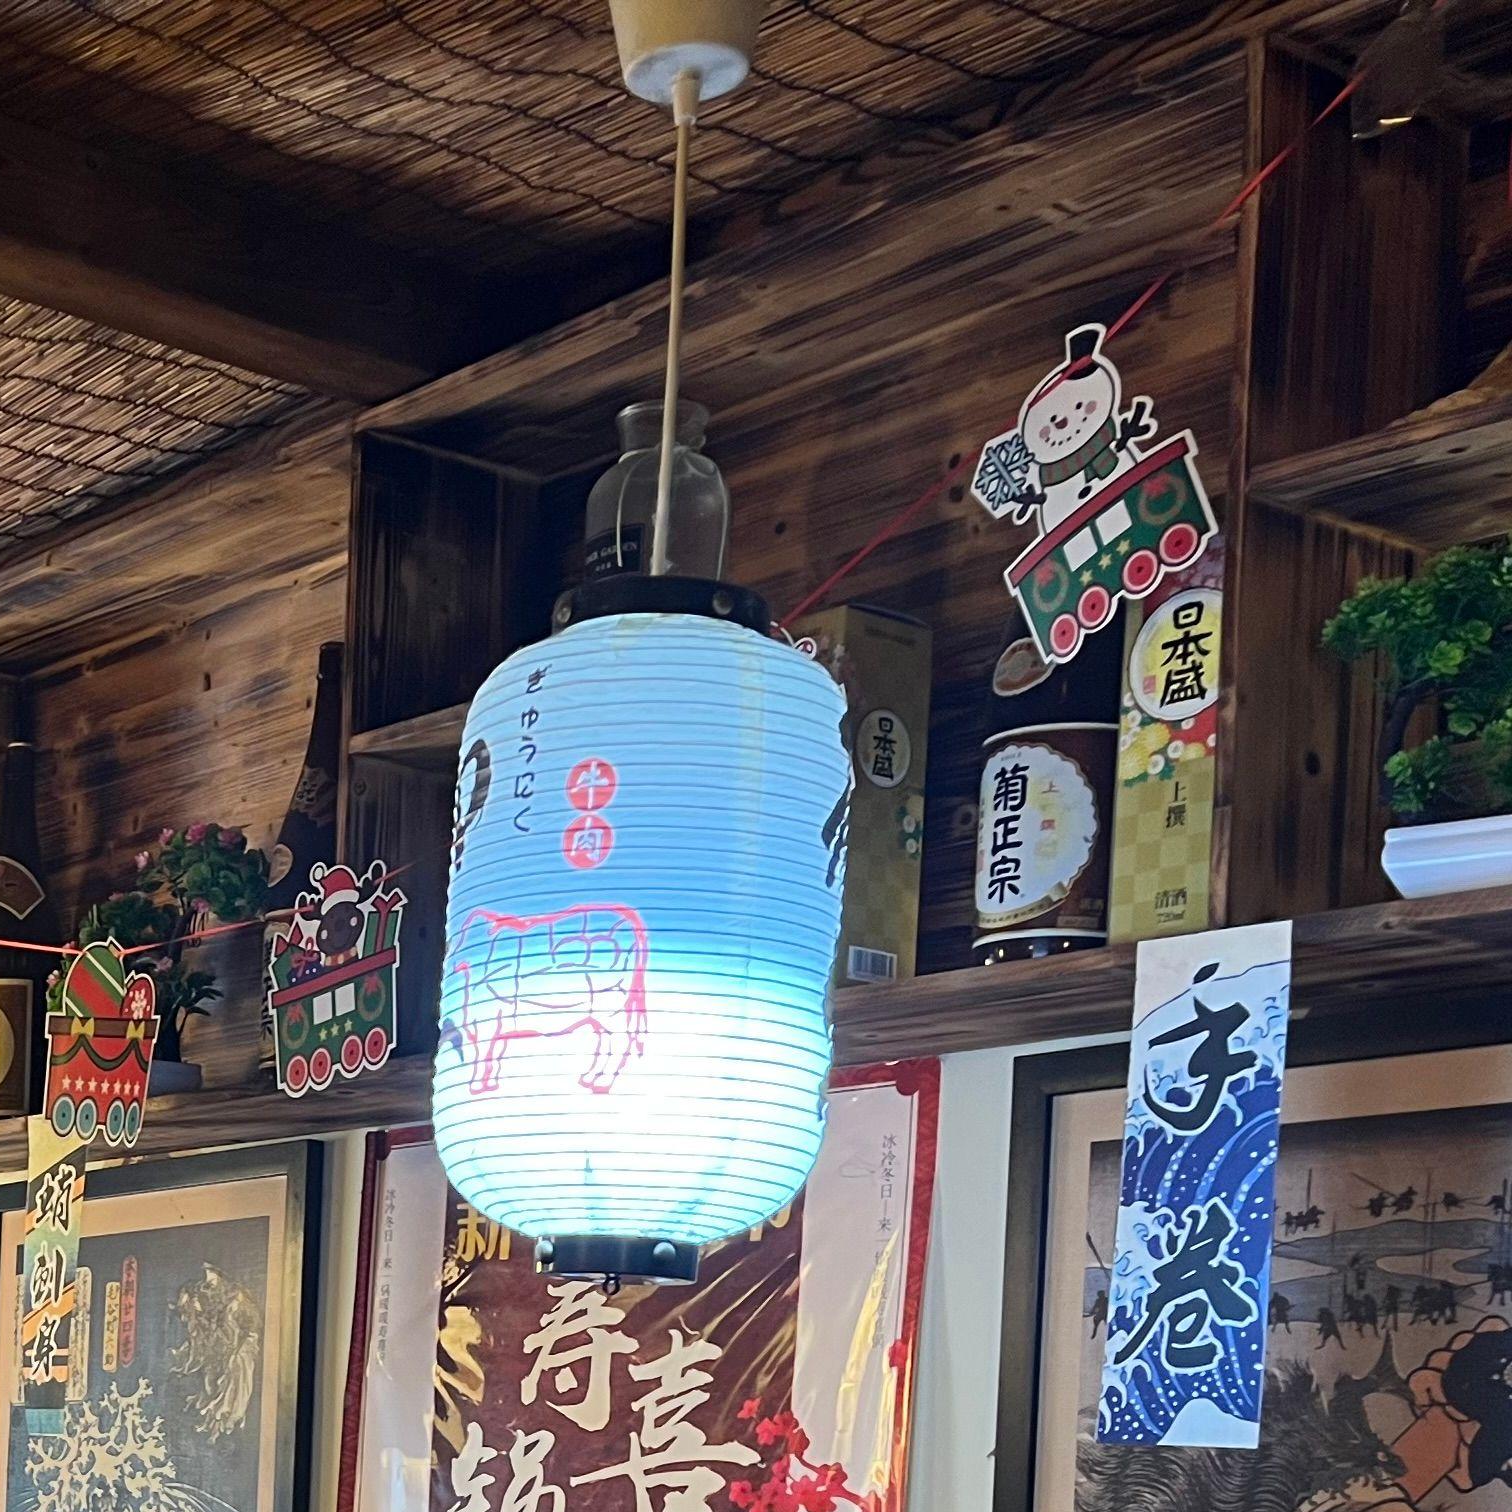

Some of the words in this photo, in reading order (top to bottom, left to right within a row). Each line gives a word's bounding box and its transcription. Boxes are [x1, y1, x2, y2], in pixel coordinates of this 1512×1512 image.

[1159, 602, 1213, 708] 日本盛
[513, 663, 552, 833] ぎゅうにく
[564, 759, 615, 865] 牛肉
[987, 763, 1030, 904] 菊正宗
